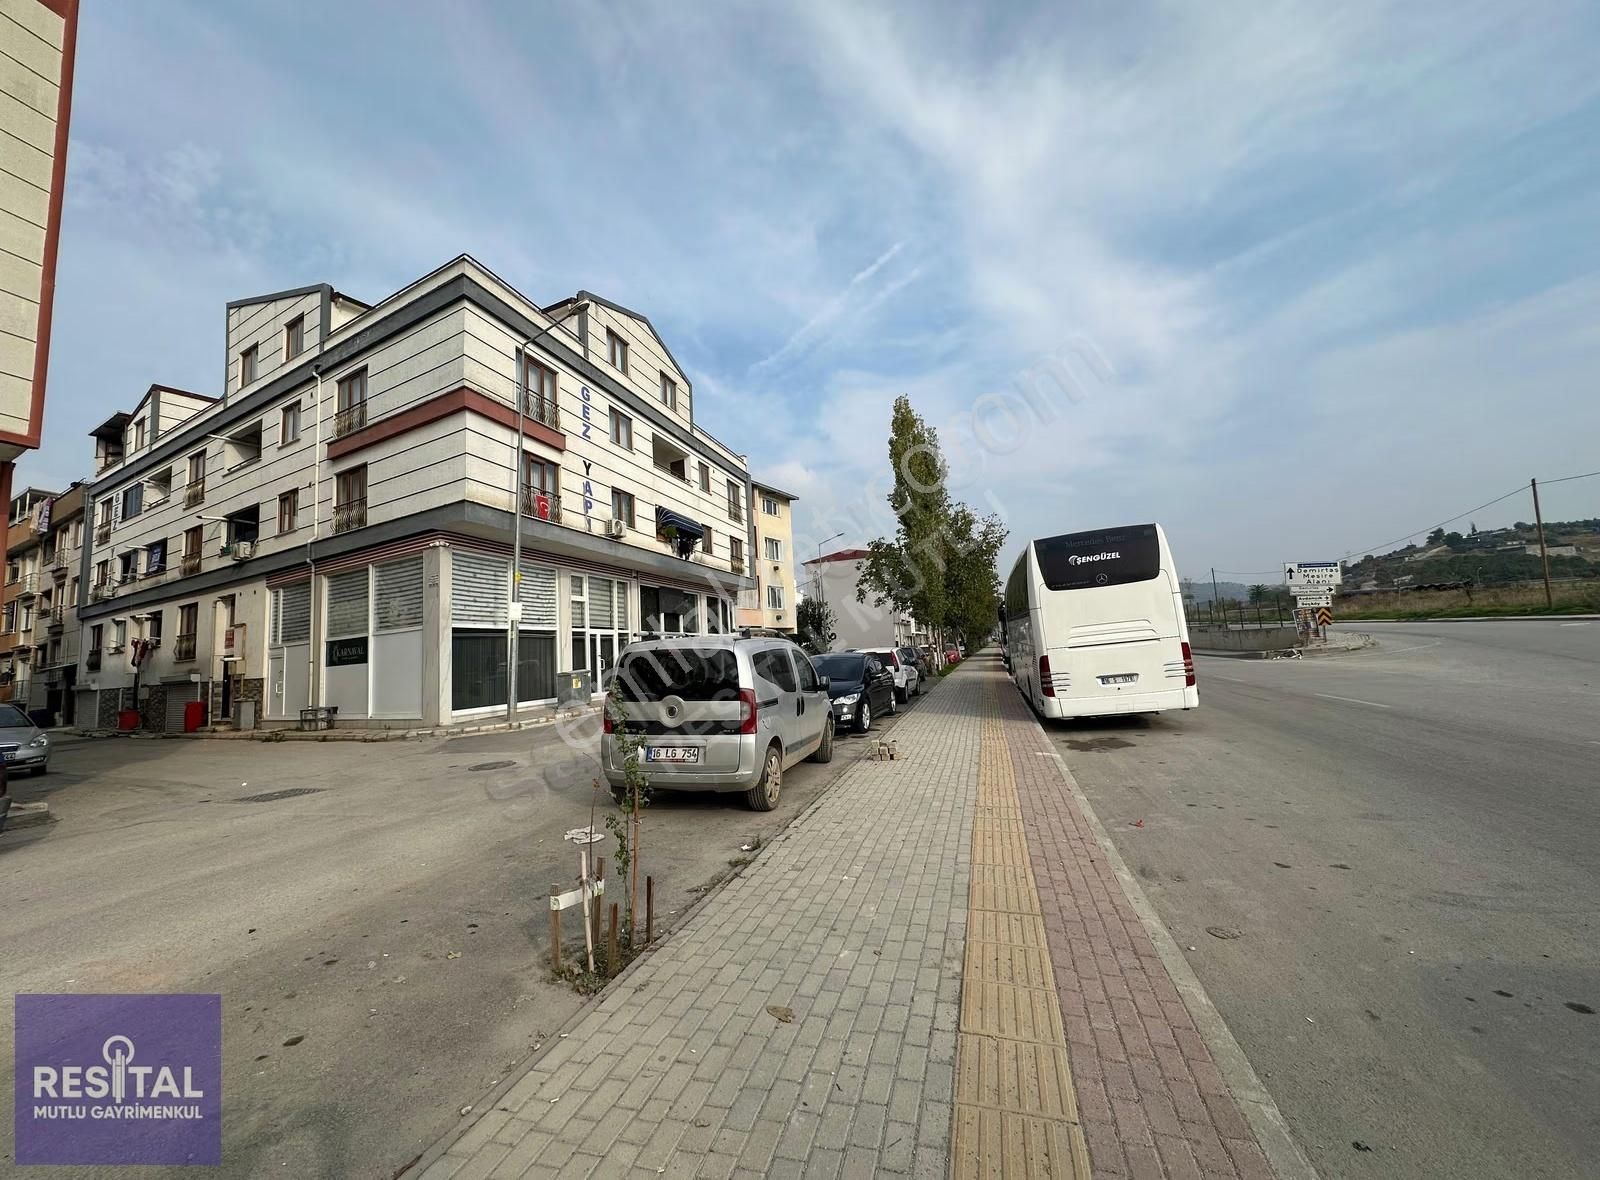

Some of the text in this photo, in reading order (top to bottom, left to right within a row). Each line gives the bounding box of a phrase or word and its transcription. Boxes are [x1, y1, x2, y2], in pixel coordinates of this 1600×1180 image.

[581, 386, 591, 439] GEZ
[1076, 552, 1121, 565] ŞENGÜZEL
[653, 748, 697, 758] 16 LG 754
